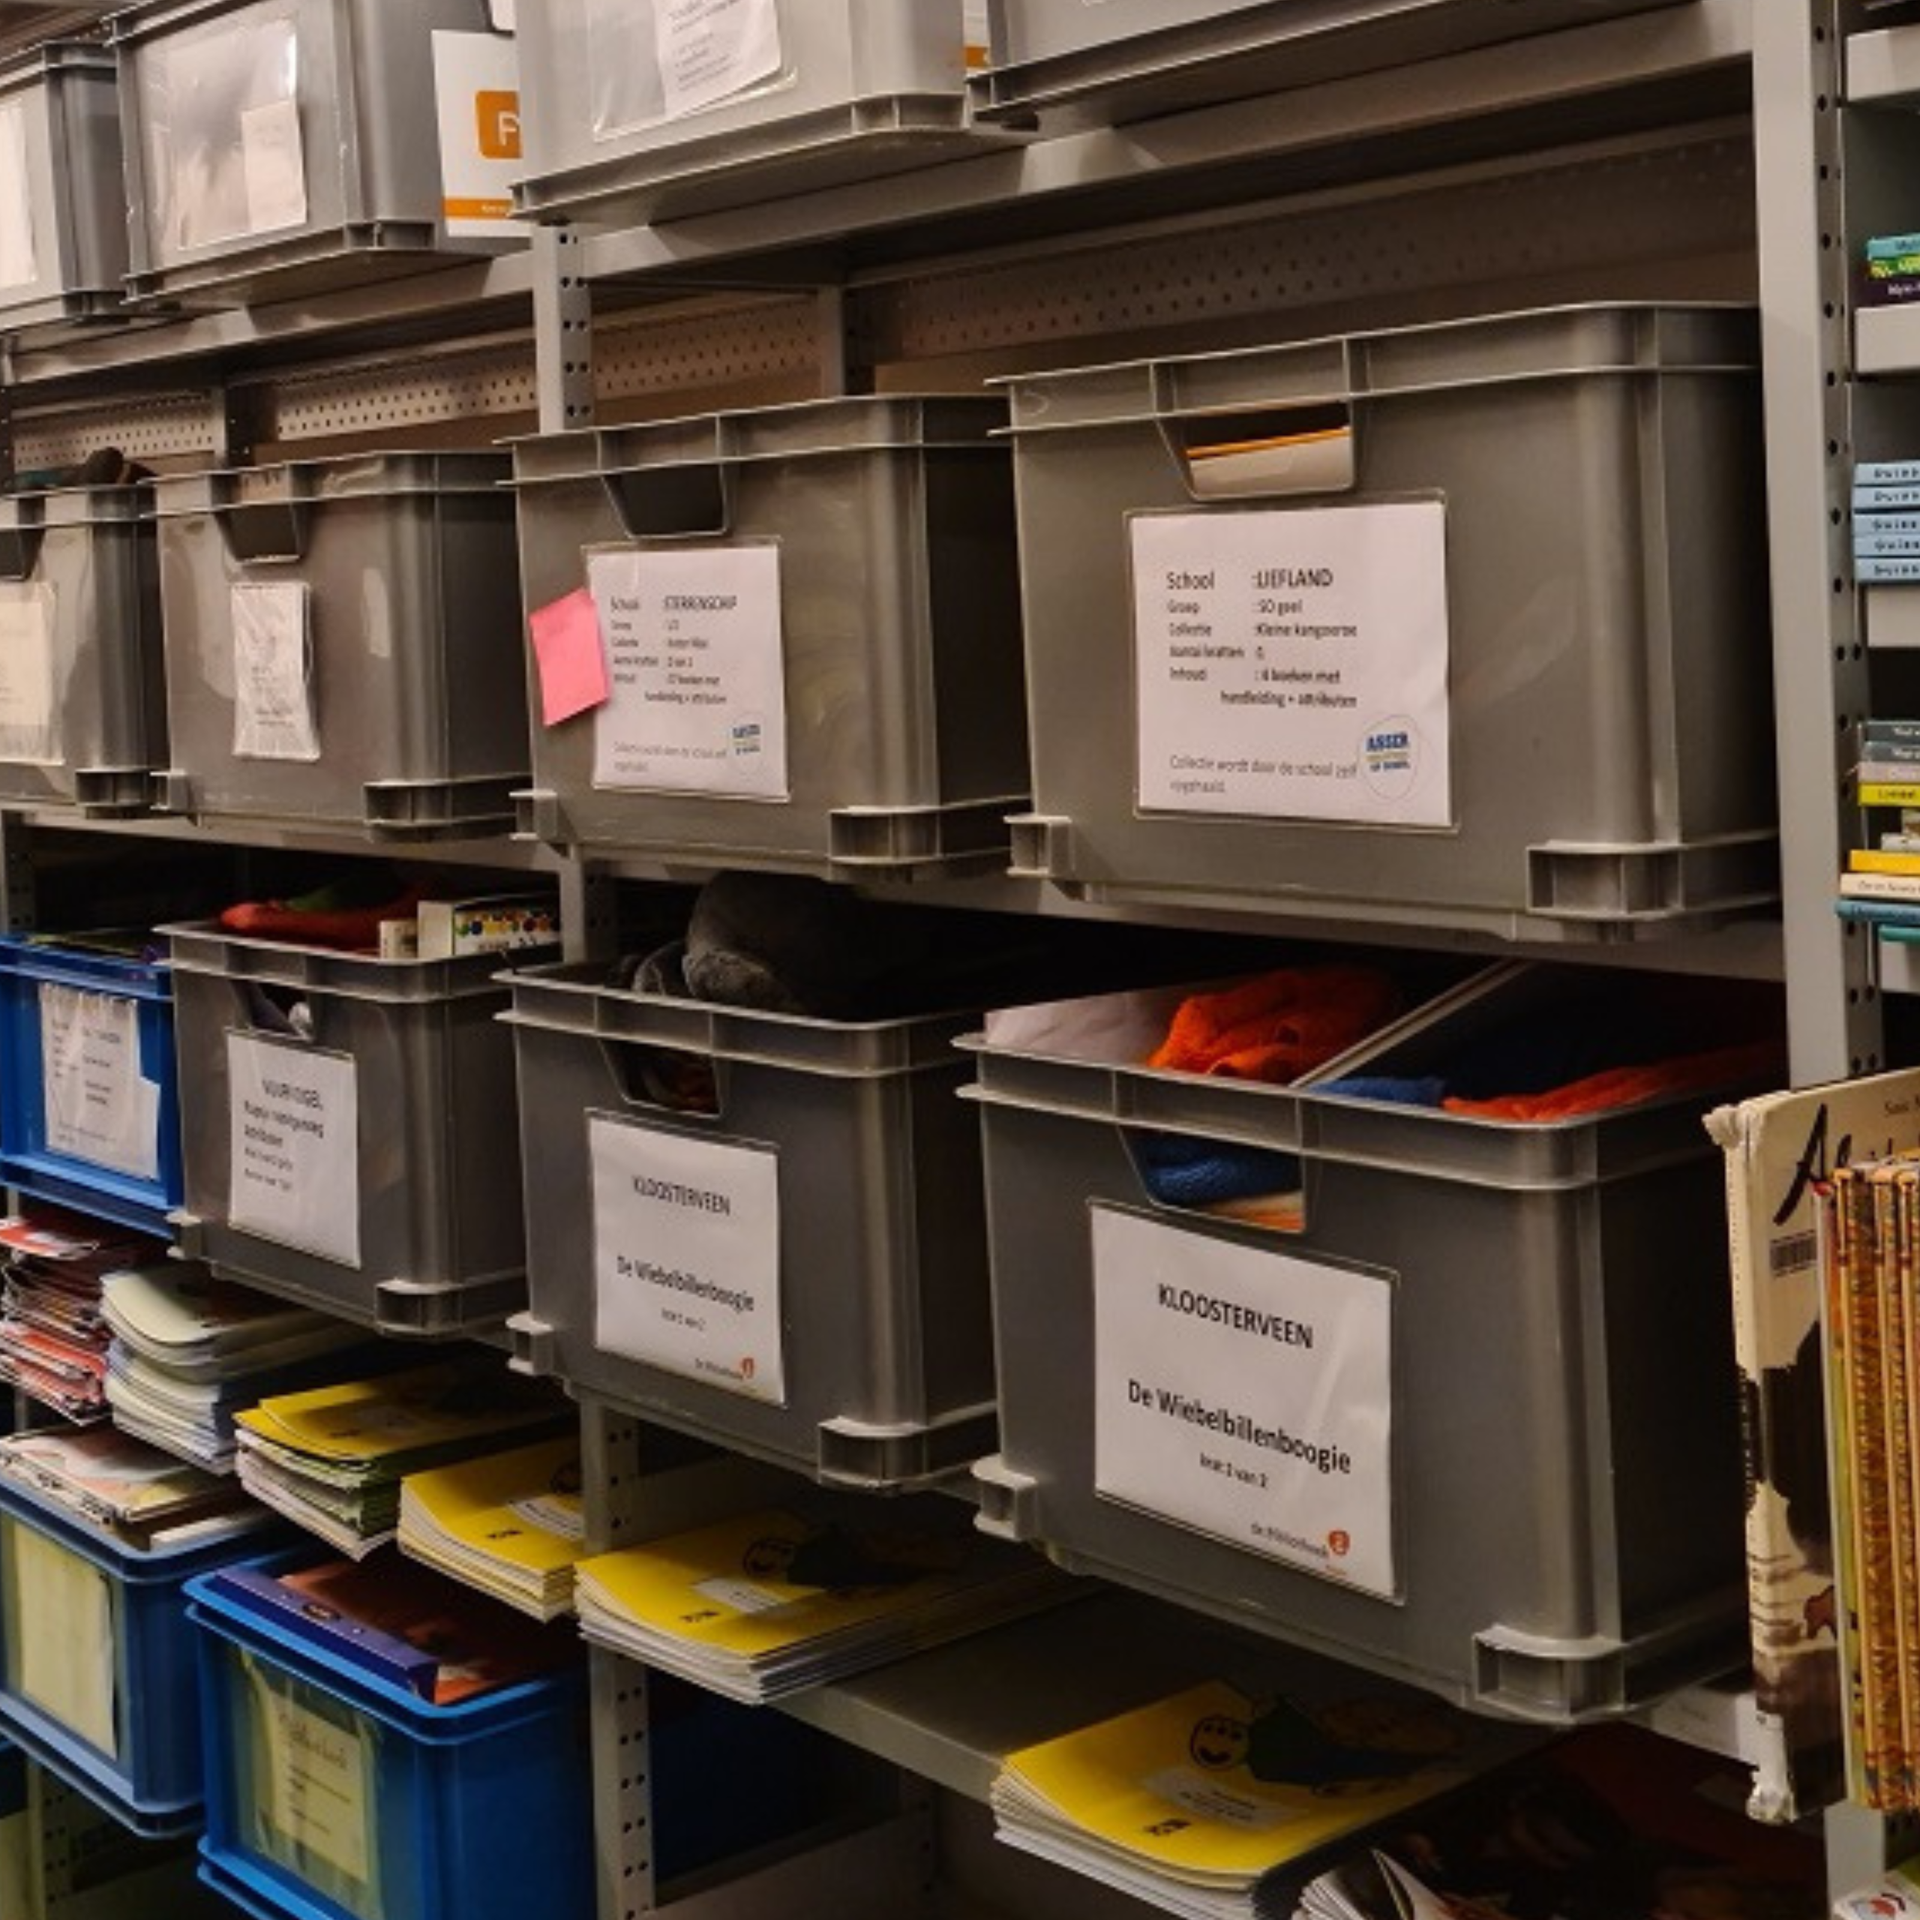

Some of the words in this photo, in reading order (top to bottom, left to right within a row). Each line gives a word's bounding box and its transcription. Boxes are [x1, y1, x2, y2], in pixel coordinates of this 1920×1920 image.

[1167, 571, 1215, 590] School
[1167, 600, 1200, 615] Groep
[1315, 669, 1341, 685] met
[632, 1175, 731, 1216] KLOOSTERVEEN
[617, 1254, 633, 1278] De
[1158, 1283, 1313, 1349] KLOOSTERVEEN
[1129, 1378, 1153, 1408] De
[1156, 1387, 1352, 1474] Wiebelbillenboogie
